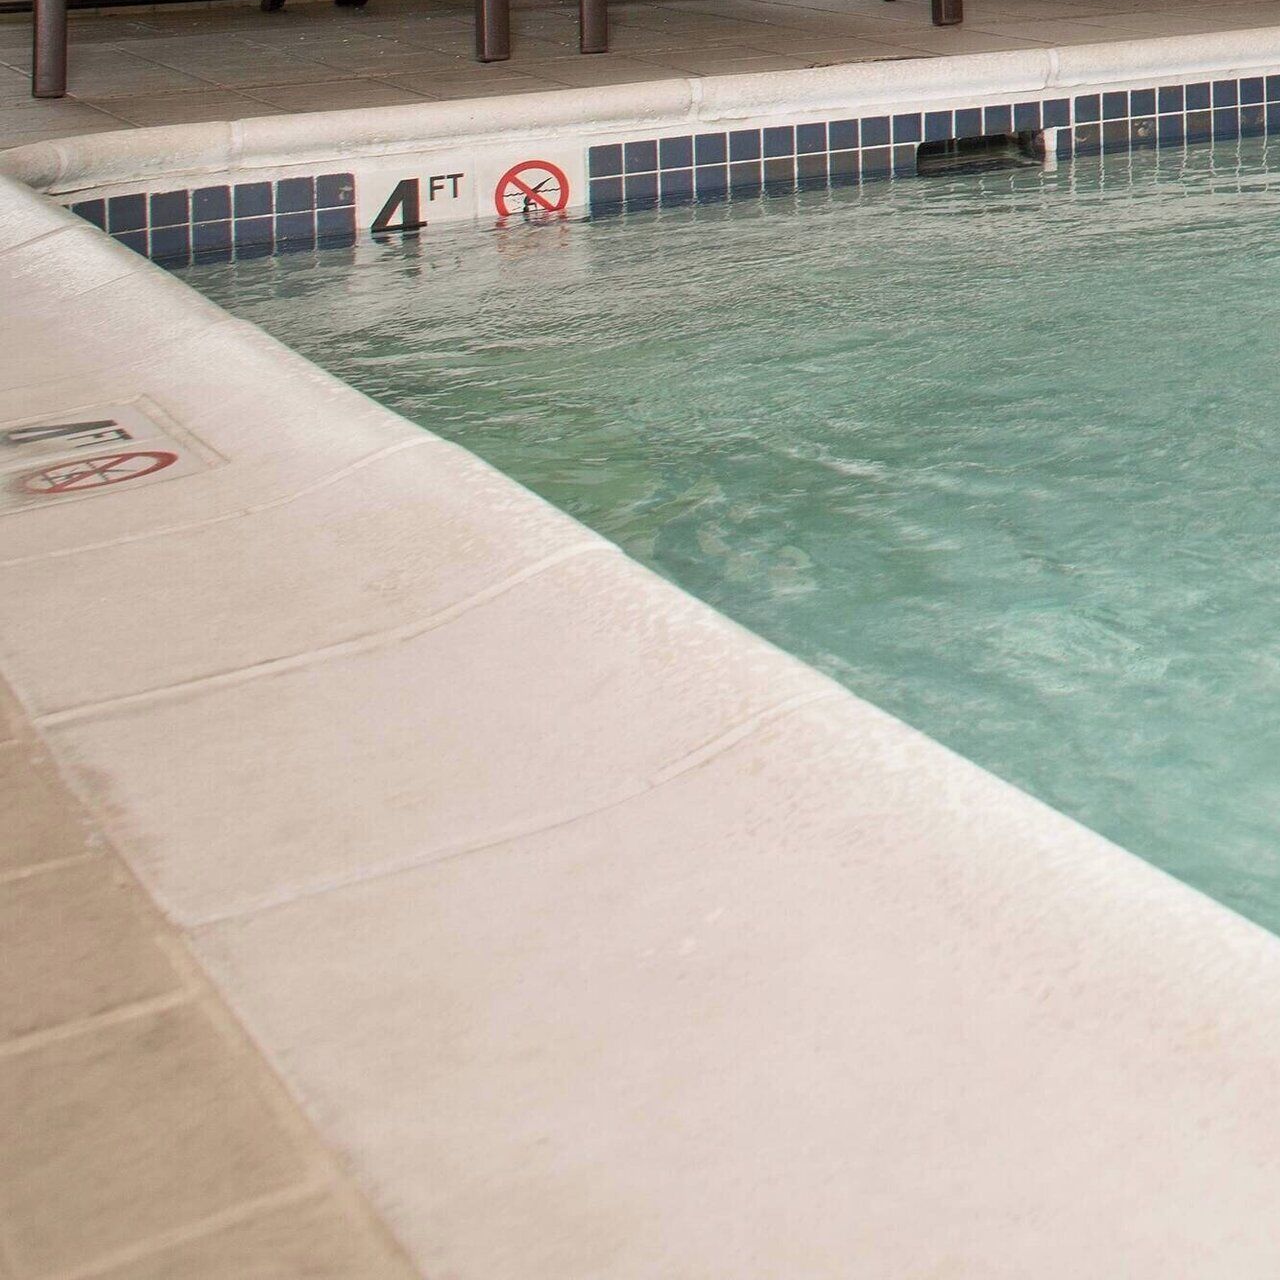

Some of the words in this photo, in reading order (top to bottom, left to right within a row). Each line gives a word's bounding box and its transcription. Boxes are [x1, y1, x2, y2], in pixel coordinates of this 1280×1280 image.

[371, 178, 428, 233] 4
[430, 173, 464, 201] FT
[66, 428, 133, 448] FT
